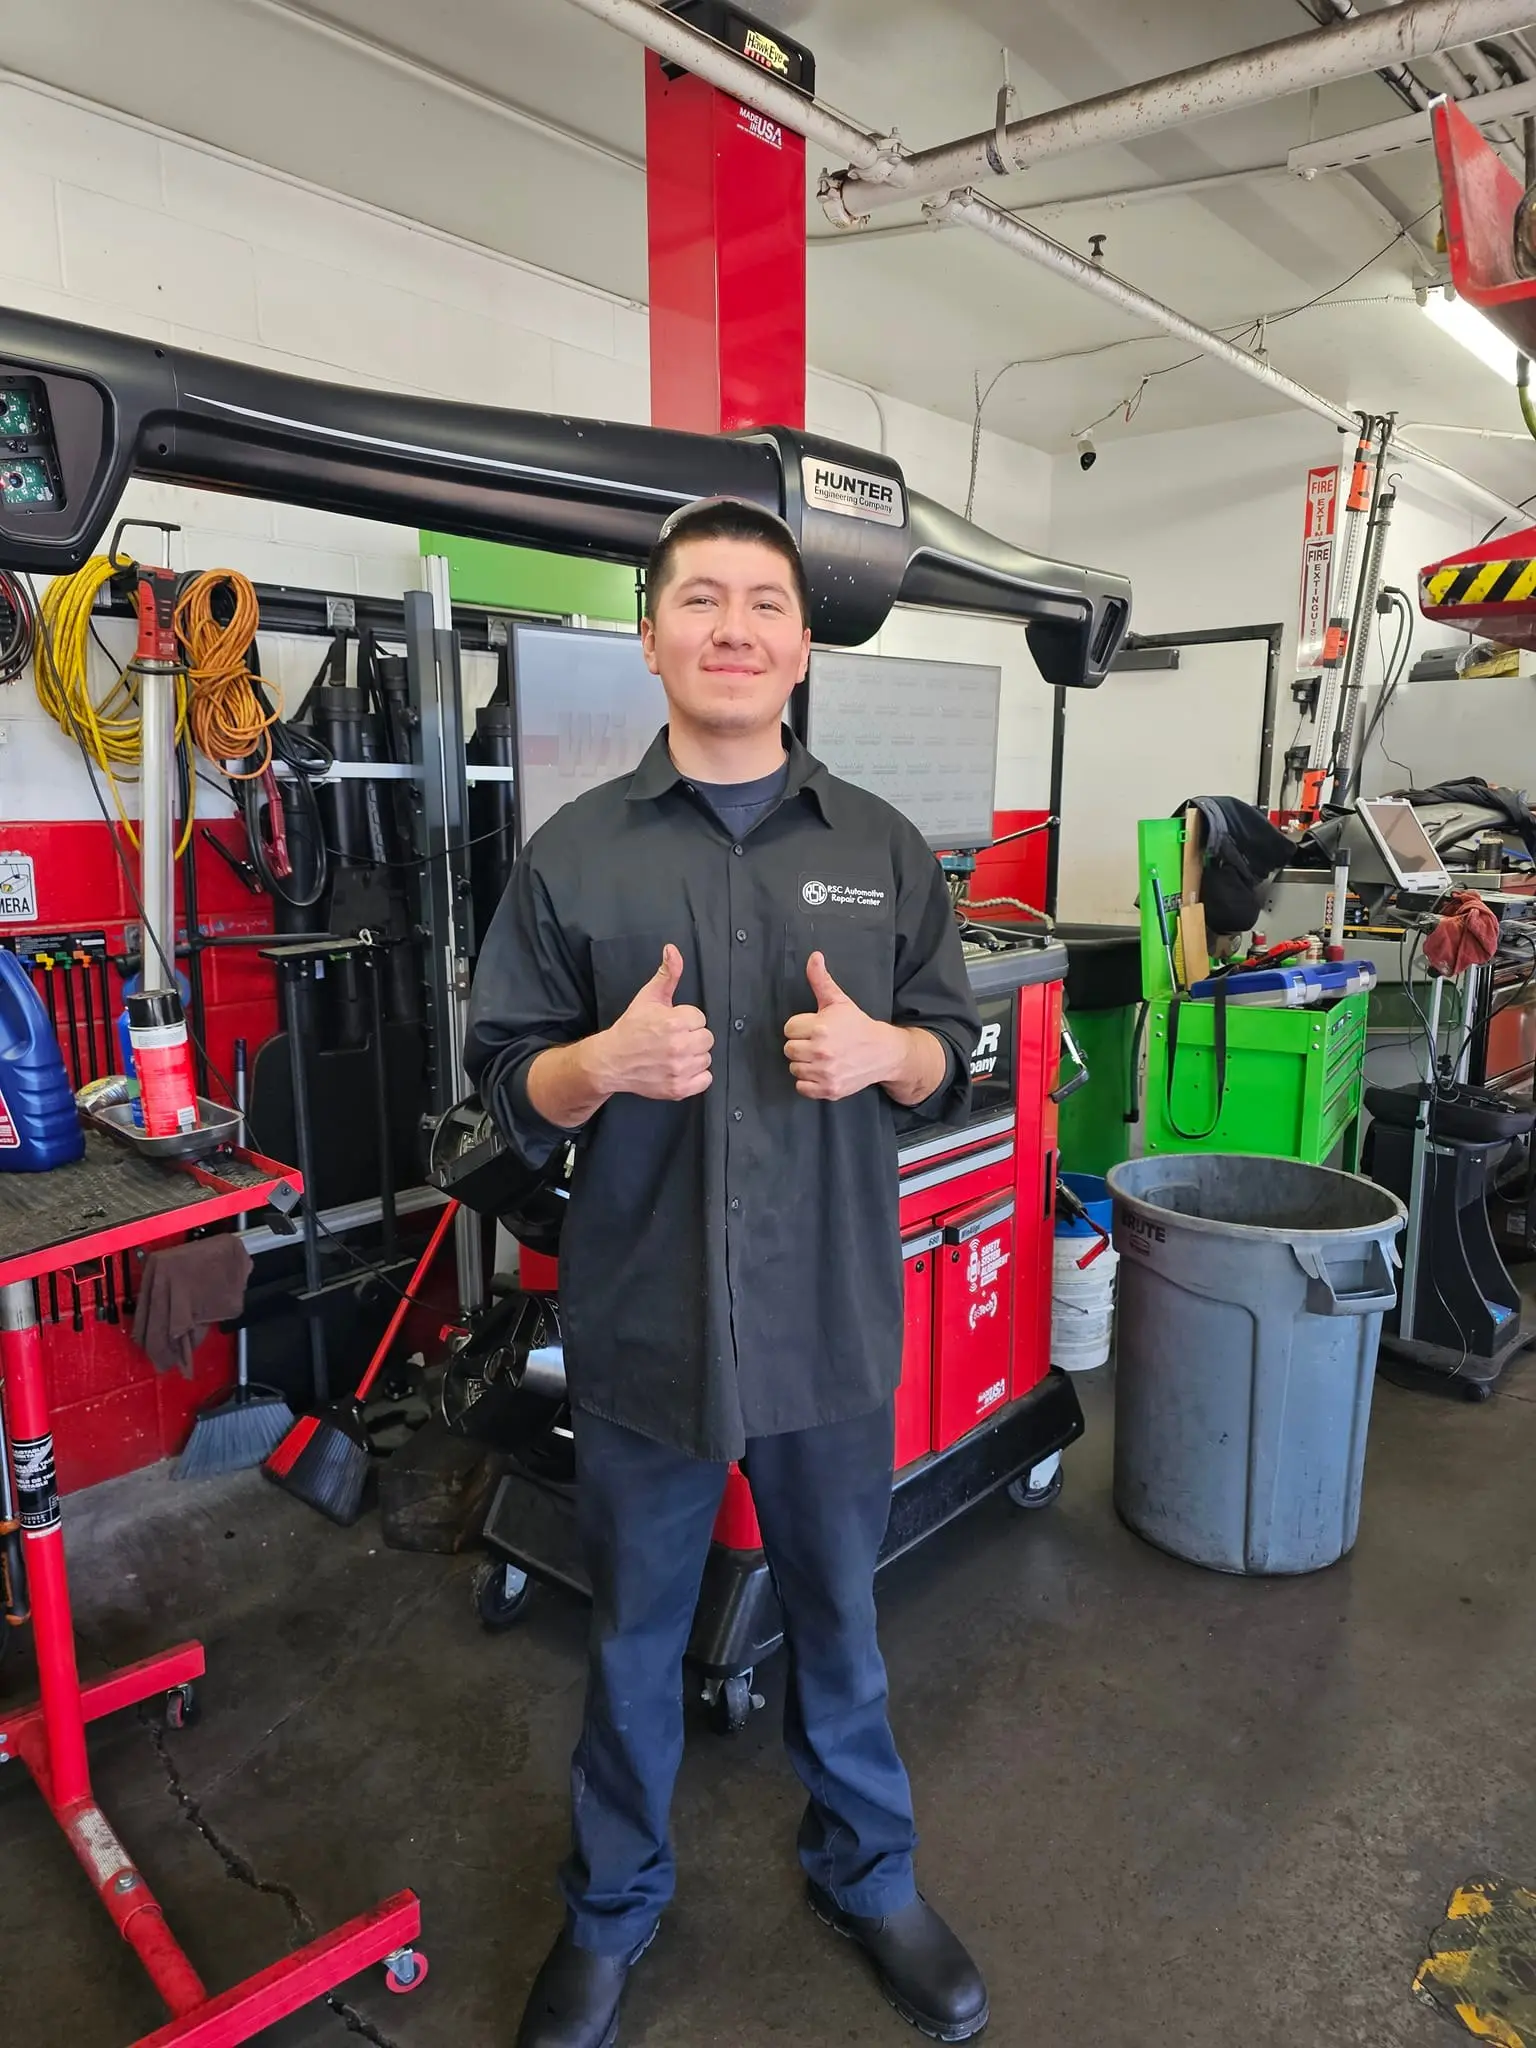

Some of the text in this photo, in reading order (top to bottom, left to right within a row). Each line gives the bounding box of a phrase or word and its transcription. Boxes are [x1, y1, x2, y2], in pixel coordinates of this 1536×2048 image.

[748, 32, 783, 63] HawkEye
[739, 107, 760, 123] MADE
[758, 117, 782, 146] USA
[815, 468, 893, 502] HUNTER
[1311, 480, 1333, 495] FIRE
[814, 486, 893, 514] Engineering Company
[1308, 549, 1330, 562] FIRE
[1310, 563, 1321, 636] EXTINGUIS
[827, 884, 884, 898] RSC Automotive
[831, 893, 881, 906] Repair Center
